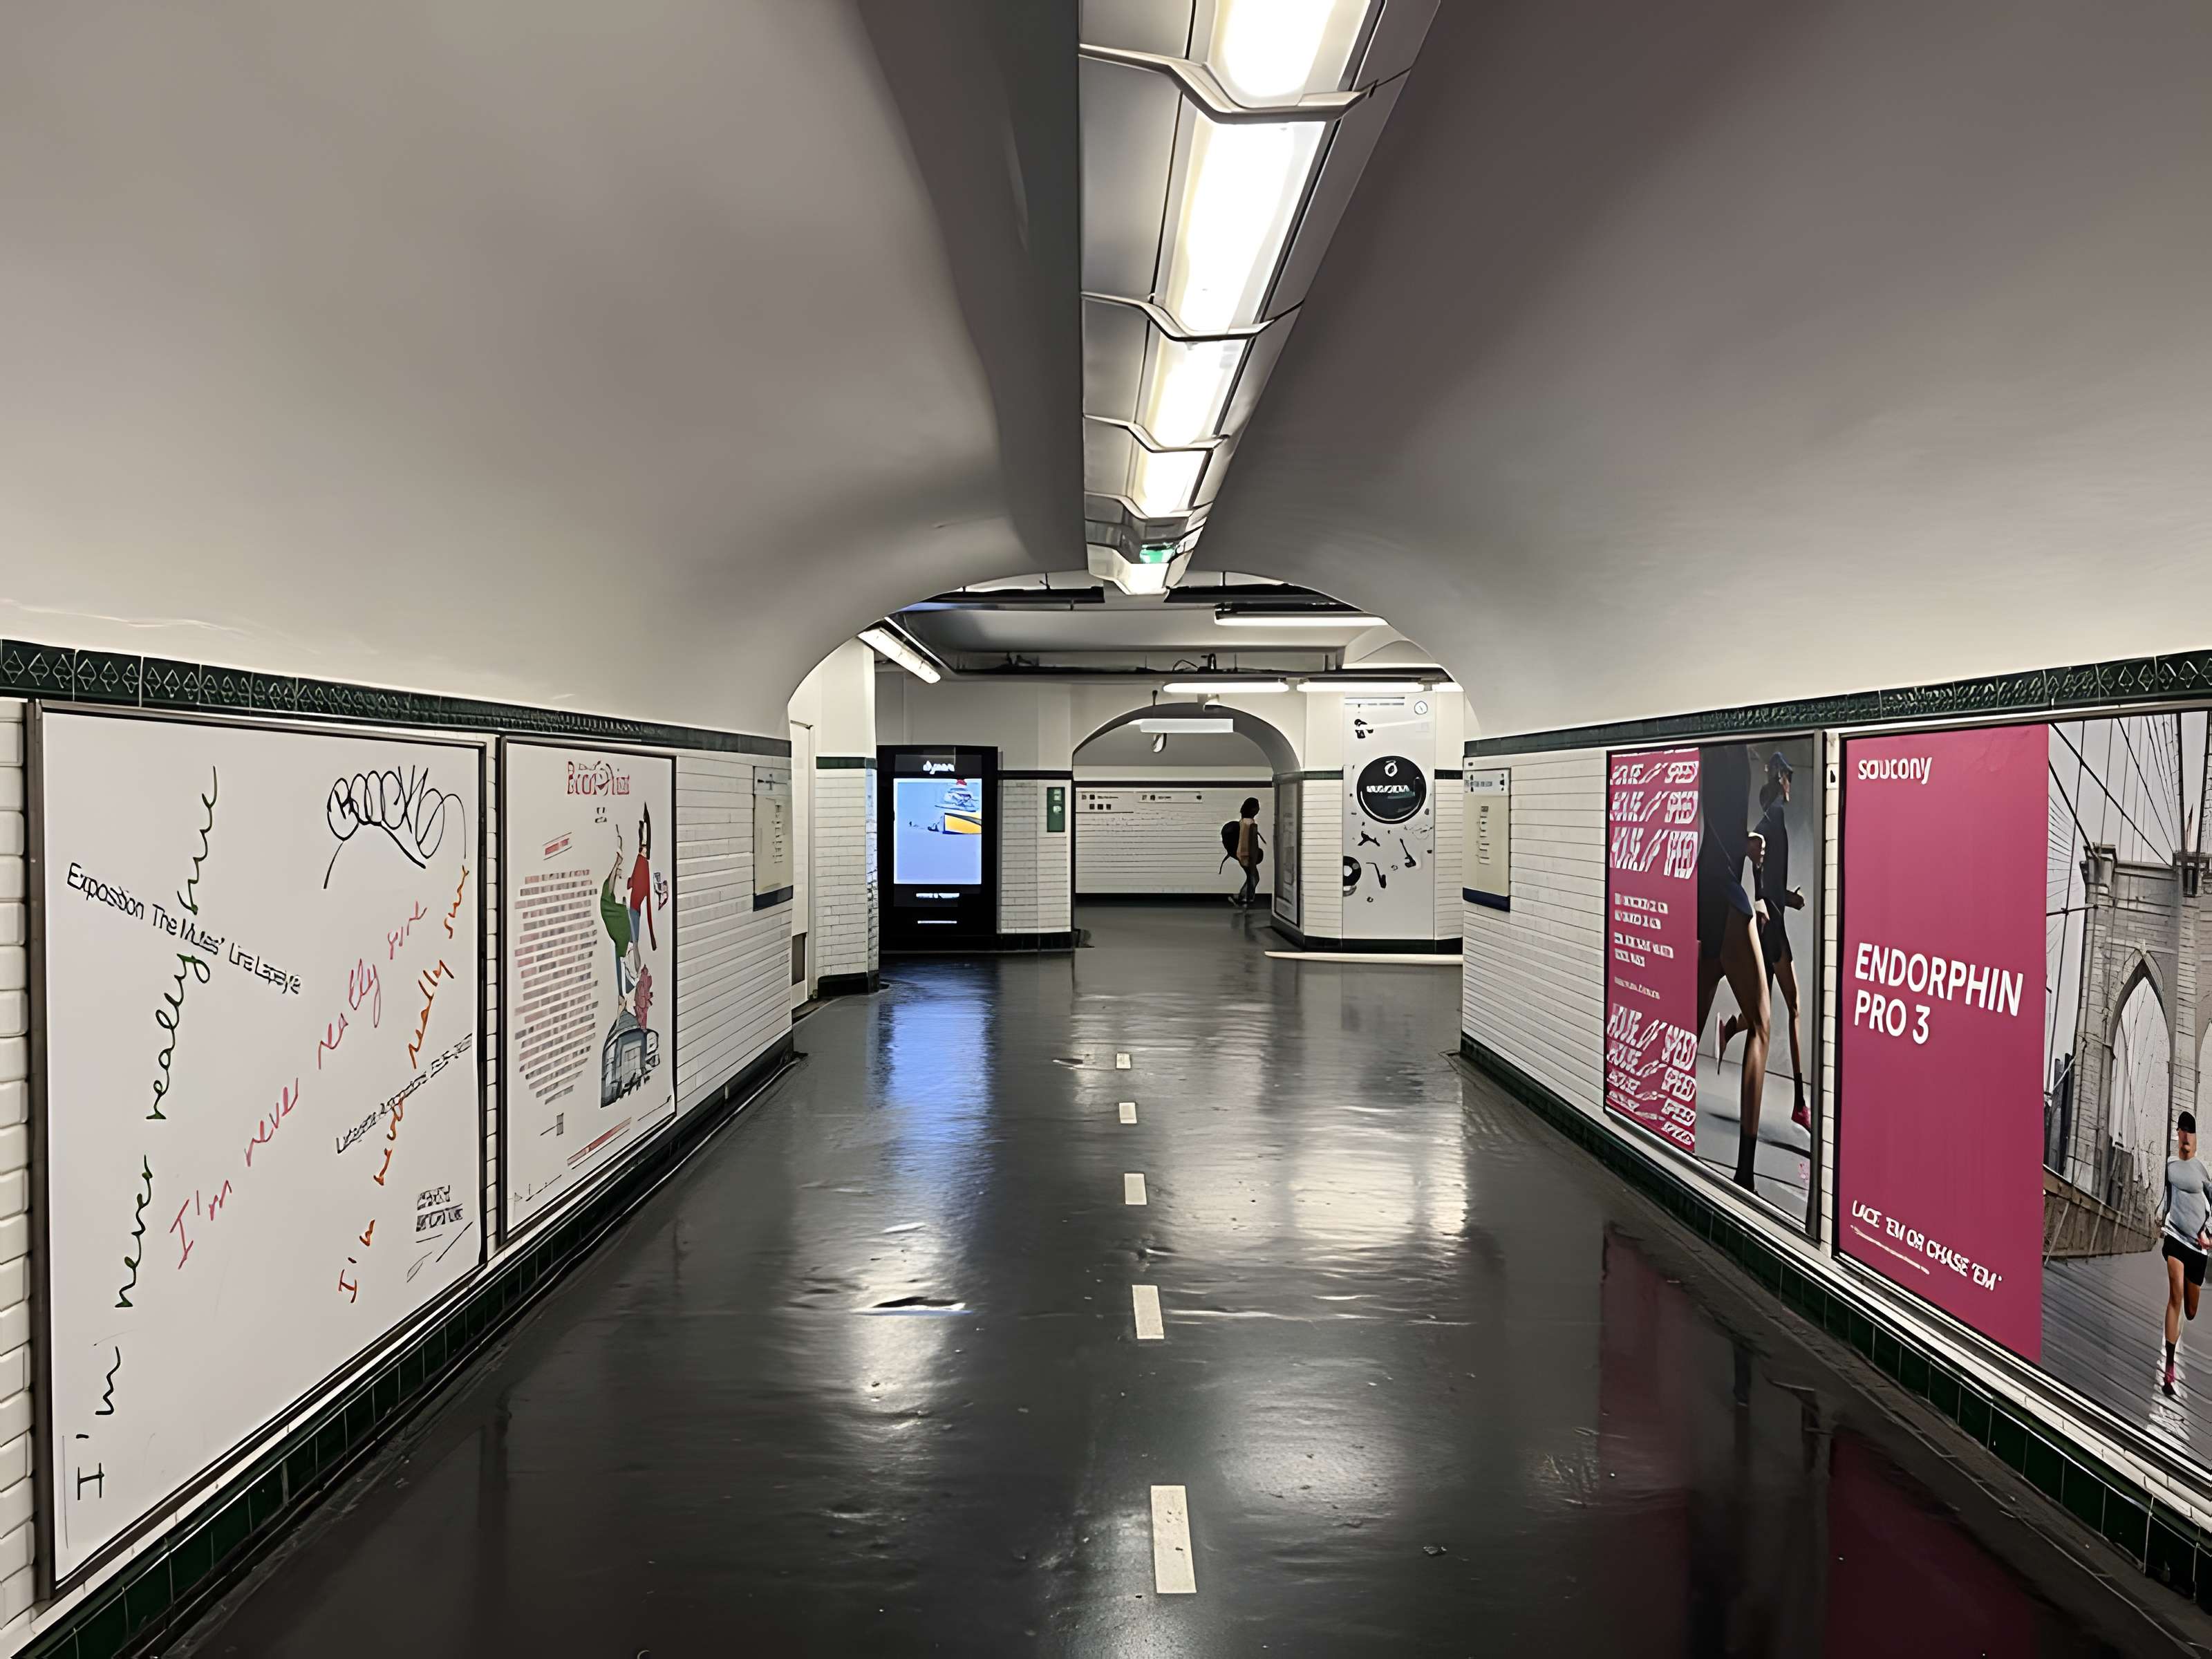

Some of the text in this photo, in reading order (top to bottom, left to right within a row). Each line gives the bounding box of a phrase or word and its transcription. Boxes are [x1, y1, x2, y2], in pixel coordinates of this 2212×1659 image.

[1858, 757, 1932, 785] saucony
[1853, 990, 1931, 1044] PRO 3
[1855, 942, 2024, 1017] ENDORPHIN
[115, 1155, 153, 1308] never
[146, 954, 210, 1120] really
[169, 1179, 232, 1270] I'm
[317, 958, 382, 1070] really
